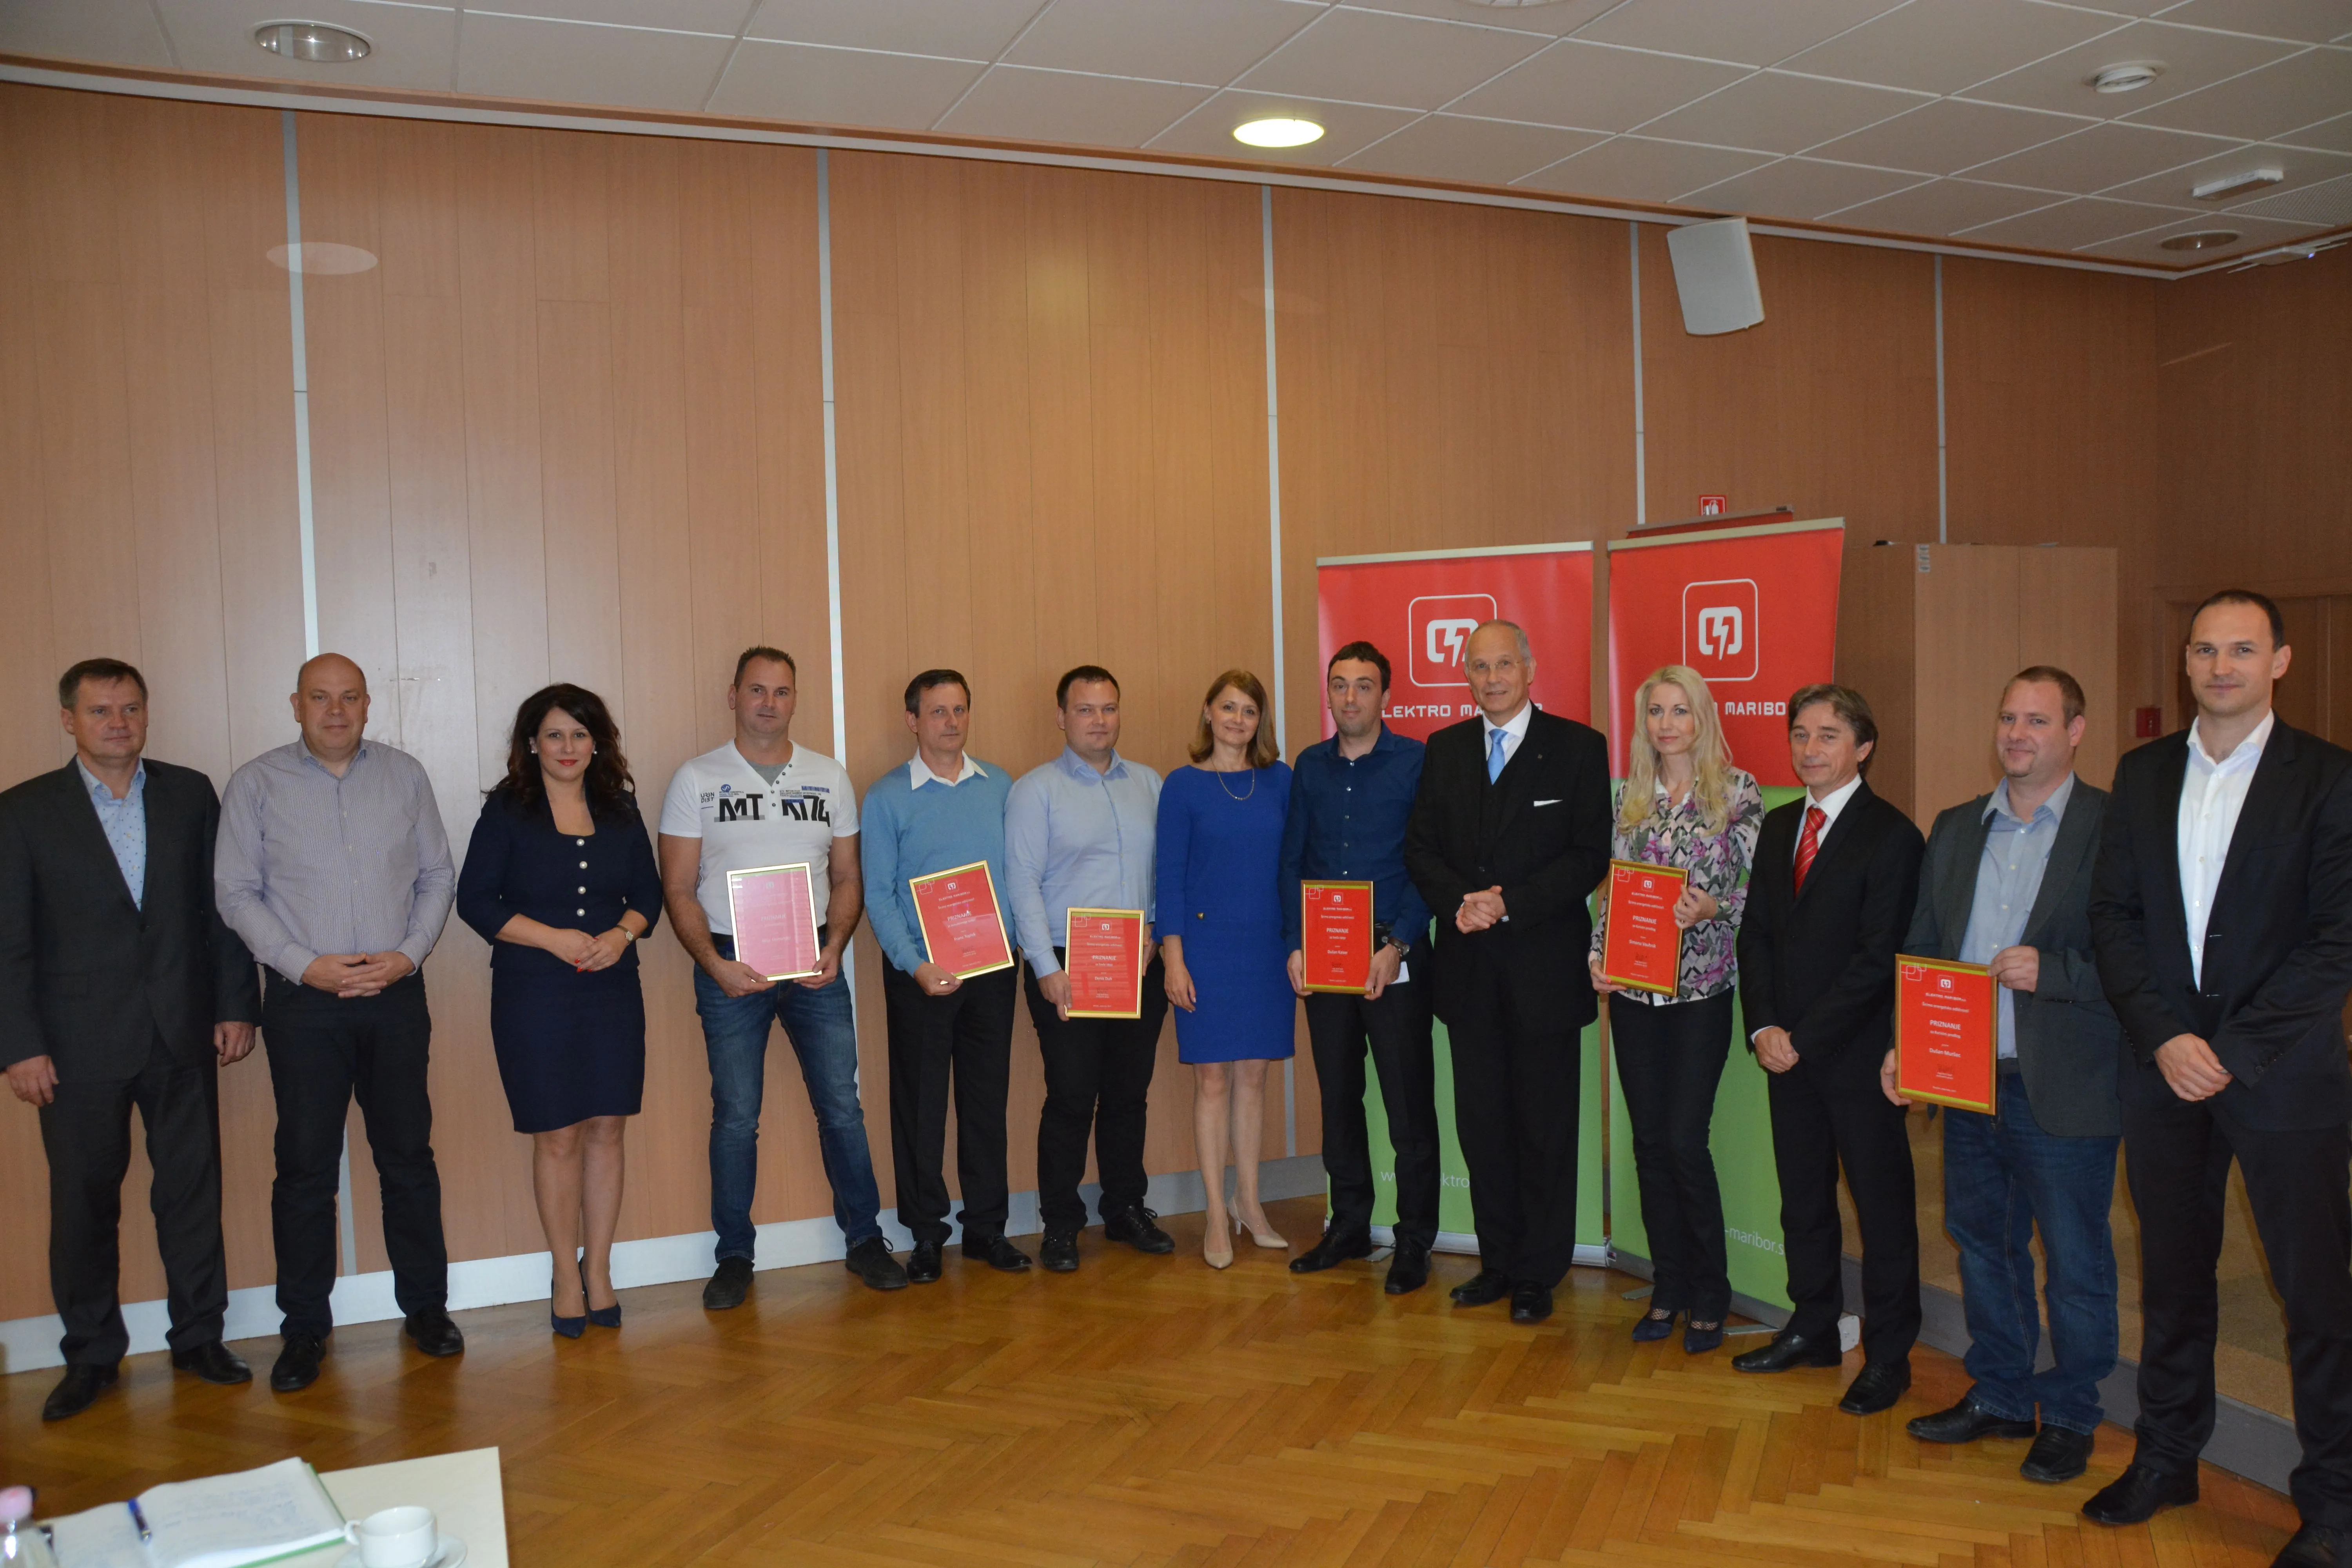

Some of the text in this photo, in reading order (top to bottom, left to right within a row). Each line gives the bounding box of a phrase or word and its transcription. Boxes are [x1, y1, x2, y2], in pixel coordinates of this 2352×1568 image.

[1382, 704, 1451, 718] LEKTRO
[1725, 701, 1786, 715] MARIBO
[947, 911, 972, 922] PRIZNANJE
[1633, 915, 1657, 924] PRIZNANJE
[1930, 1020, 1961, 1030] PRIZNANJE
